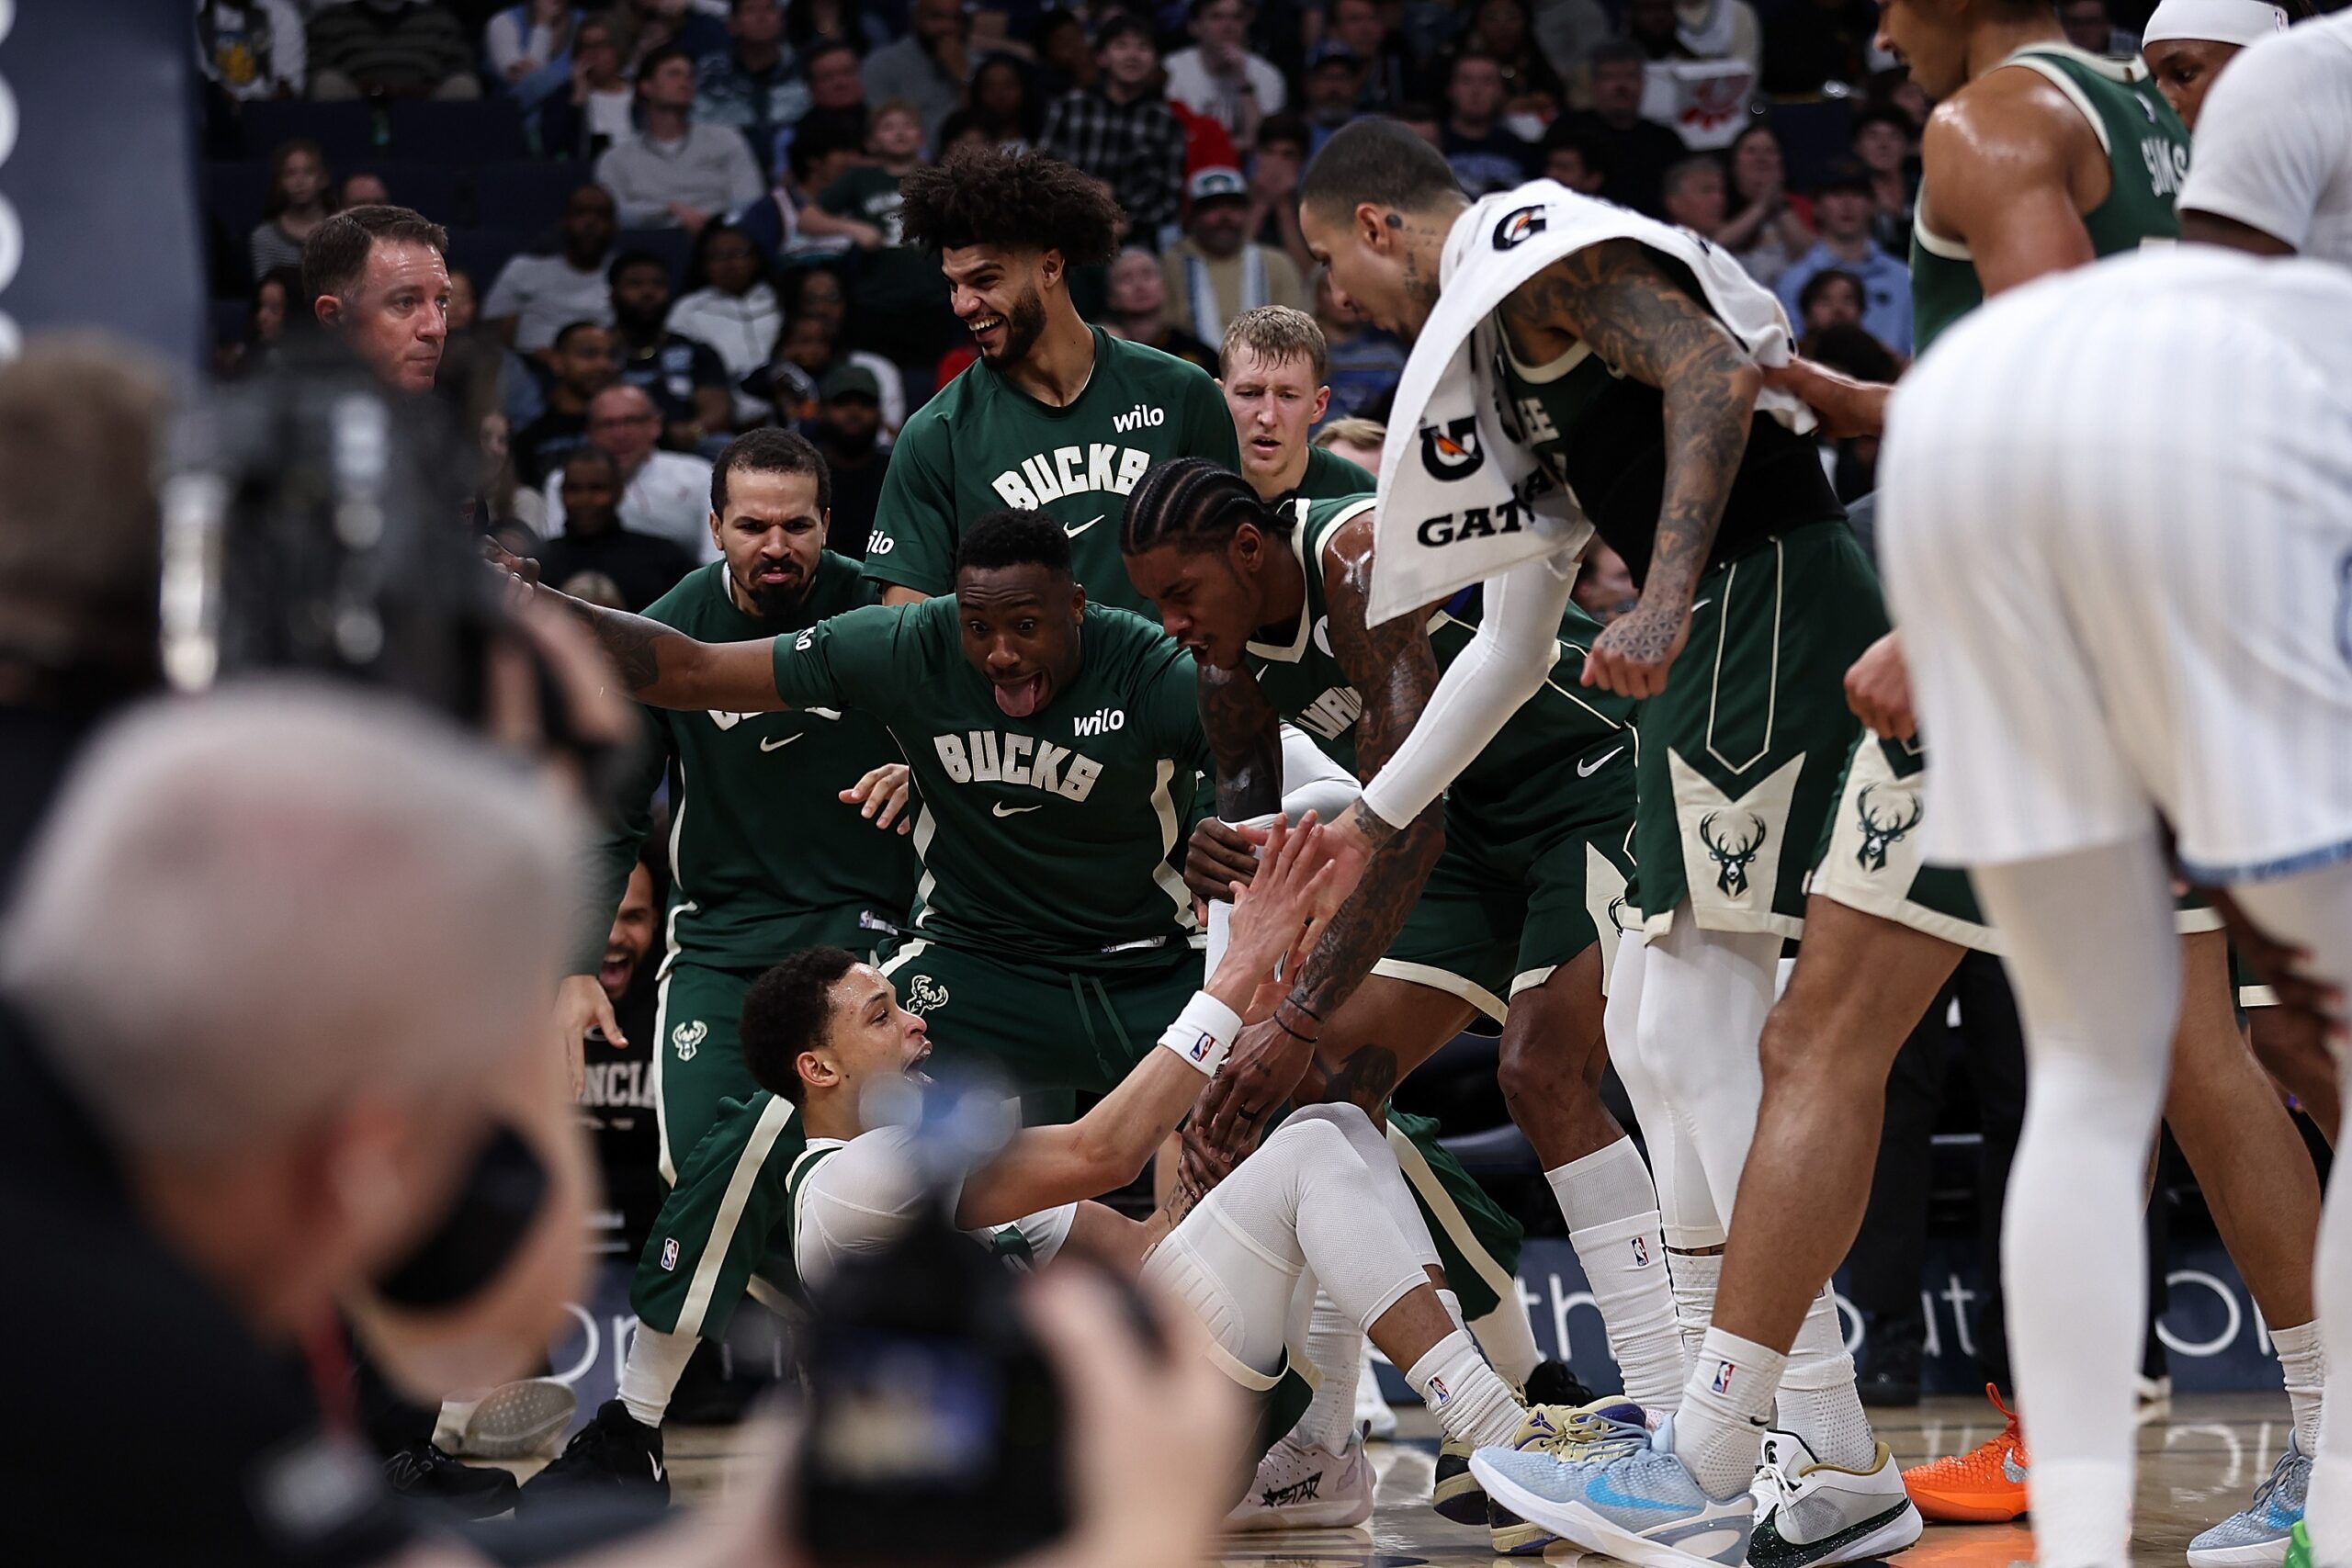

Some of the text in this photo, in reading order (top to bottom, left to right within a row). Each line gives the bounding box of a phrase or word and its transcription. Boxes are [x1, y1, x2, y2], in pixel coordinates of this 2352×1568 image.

[1113, 404, 1164, 433] wilo
[991, 443, 1150, 511] BUCKS
[866, 529, 895, 555] ilo
[1074, 707, 1125, 737] wilo
[933, 730, 1104, 803] BUCKS
